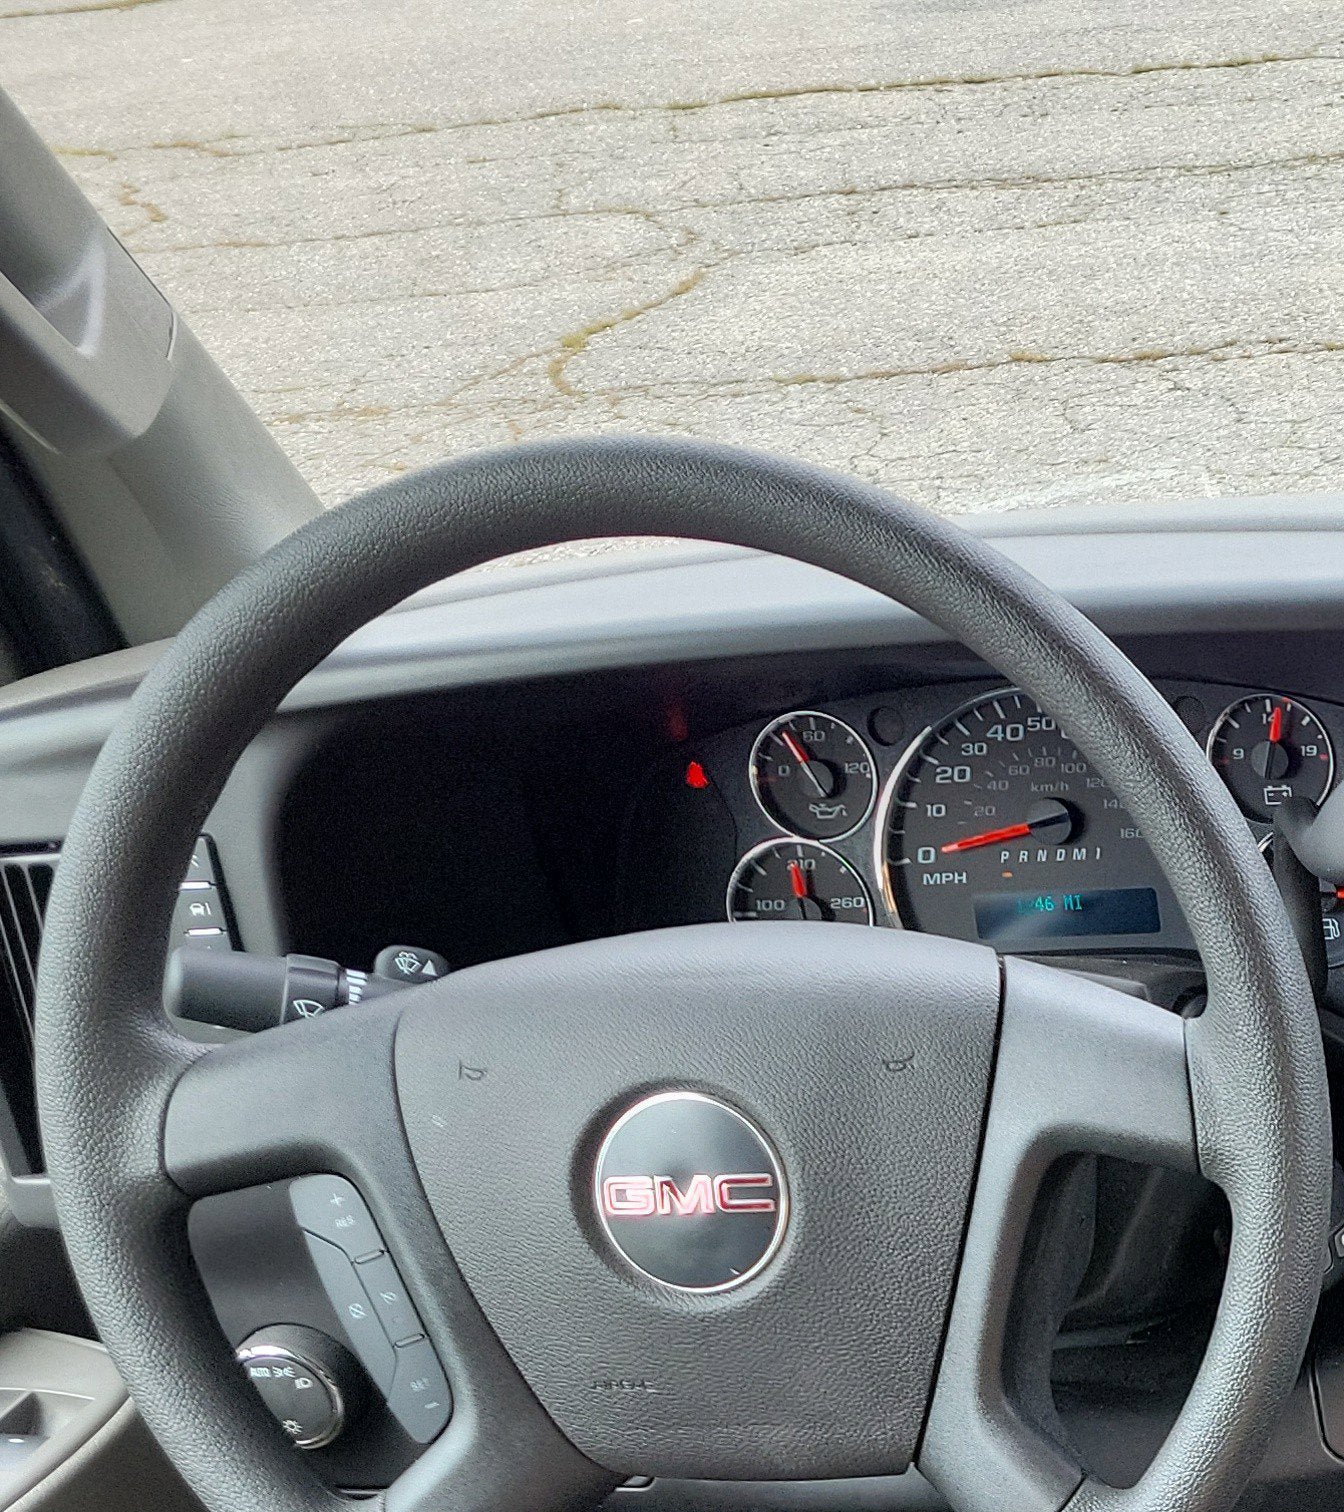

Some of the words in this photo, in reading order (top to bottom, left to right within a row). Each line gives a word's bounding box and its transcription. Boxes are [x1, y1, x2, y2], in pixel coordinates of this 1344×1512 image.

[1027, 717, 1056, 731] 50
[986, 724, 1025, 741] 40
[961, 742, 988, 756] 30
[1232, 748, 1245, 760] 9
[1300, 745, 1318, 757] 19
[844, 761, 870, 774] 120
[1034, 757, 1056, 768] 80
[1060, 763, 1087, 774] 100
[777, 765, 790, 777] 0
[935, 766, 971, 784] 20
[1008, 764, 1030, 776] 60
[986, 780, 1009, 791] 40
[1030, 781, 1069, 793] km/h
[926, 803, 946, 818] 10
[973, 805, 996, 817] 20
[917, 846, 936, 864] 0
[922, 871, 967, 885] MPH
[756, 899, 785, 911] 100
[830, 897, 865, 909] 260
[603, 1173, 776, 1215] GMC
